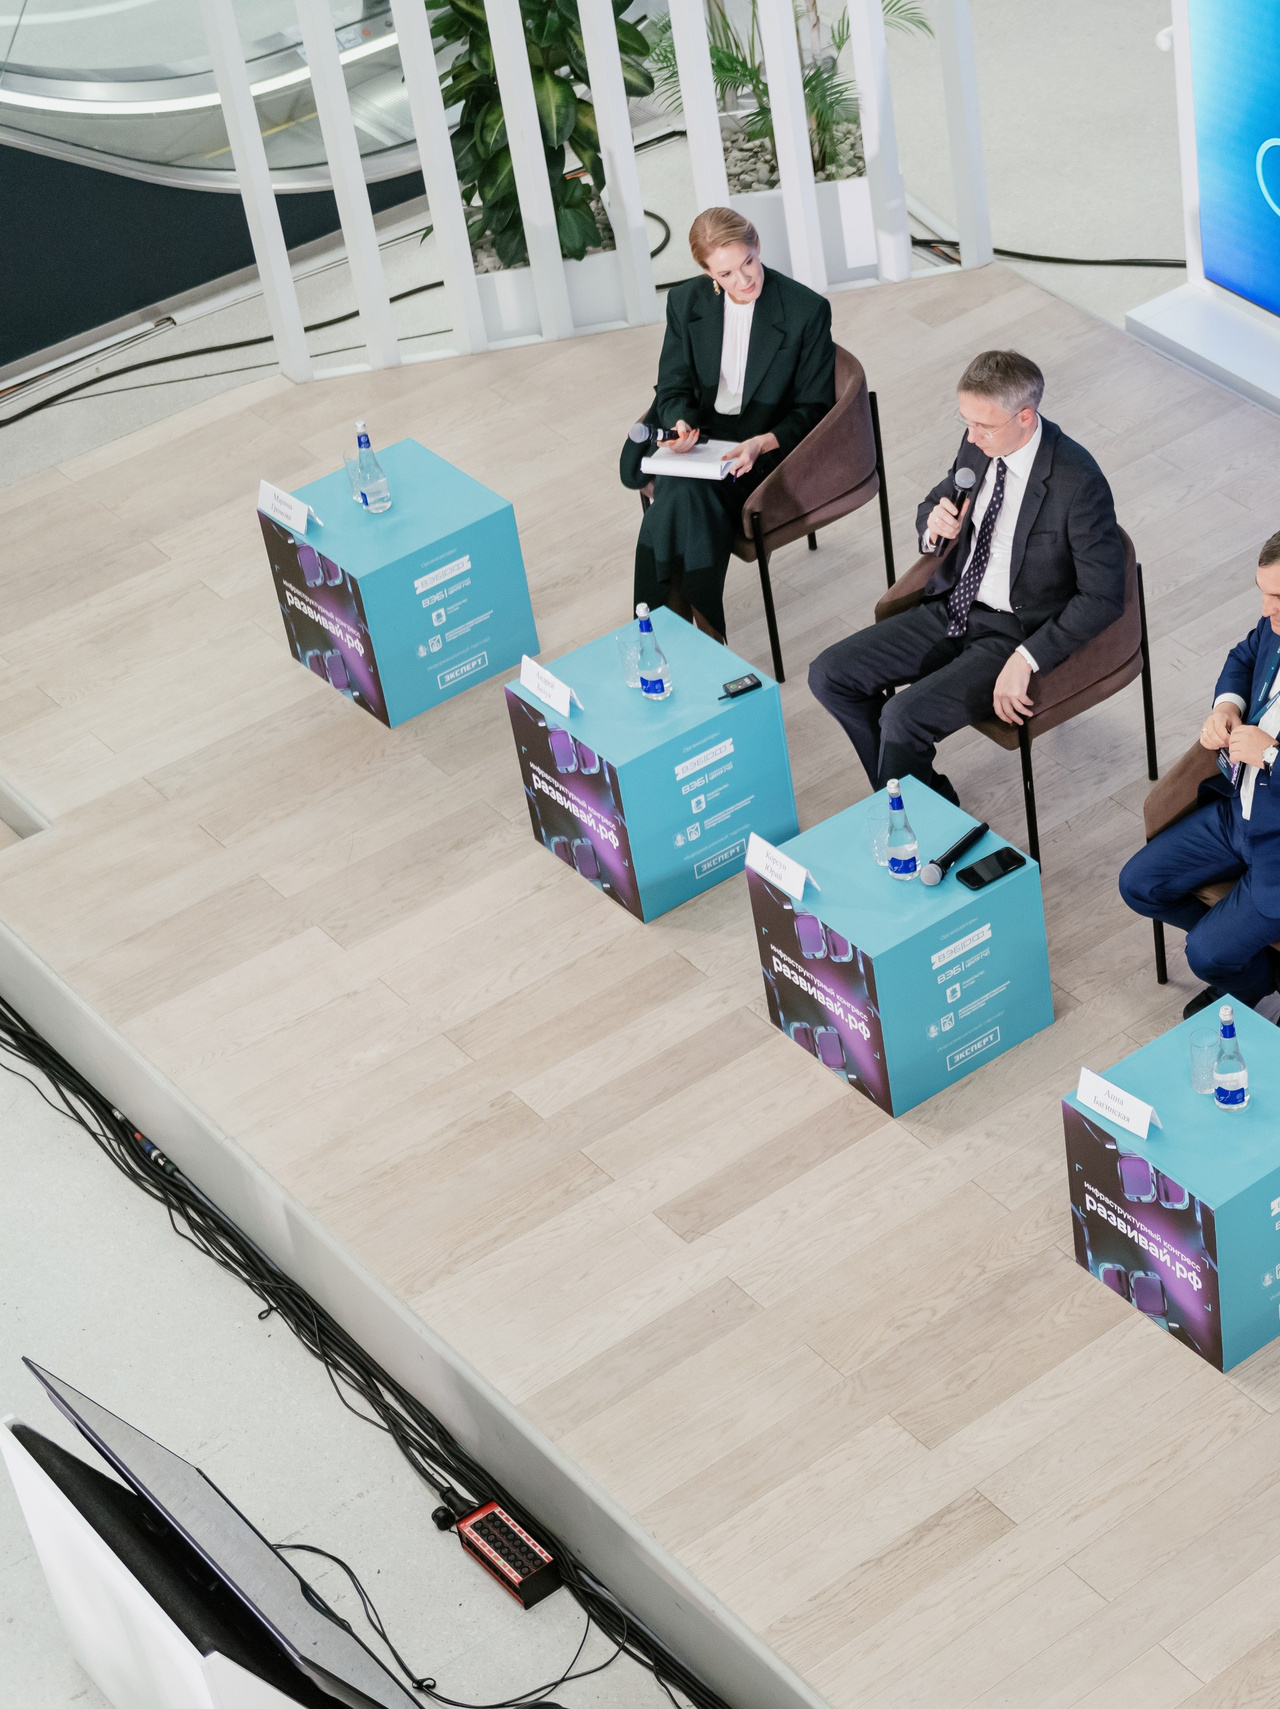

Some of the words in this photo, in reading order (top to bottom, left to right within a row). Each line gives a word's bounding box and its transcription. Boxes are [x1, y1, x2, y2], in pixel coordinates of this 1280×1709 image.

[422, 590, 445, 609] ВЭБ
[285, 590, 365, 657] развивай.рф
[444, 657, 482, 683] ЭКСПЕРТ
[681, 776, 706, 795] ВЭБ
[532, 772, 620, 850] развивай.рф
[701, 845, 741, 872] ЭКСПЕРТ
[764, 863, 783, 881] Юрий
[765, 850, 787, 872] Корсун
[770, 943, 836, 997] инфраструктурный
[836, 994, 869, 1022] конгресс
[937, 964, 962, 985] ВЭБ
[772, 955, 871, 1041] развивай.рф
[953, 1033, 995, 1063] ЭКСПЕРТ
[1092, 1096, 1131, 1124] Багинская
[1103, 1090, 1124, 1106] Анна
[1083, 1181, 1162, 1243] инфраструктурный
[1162, 1240, 1202, 1273] конгресс
[1085, 1193, 1203, 1292] развивай.рф
